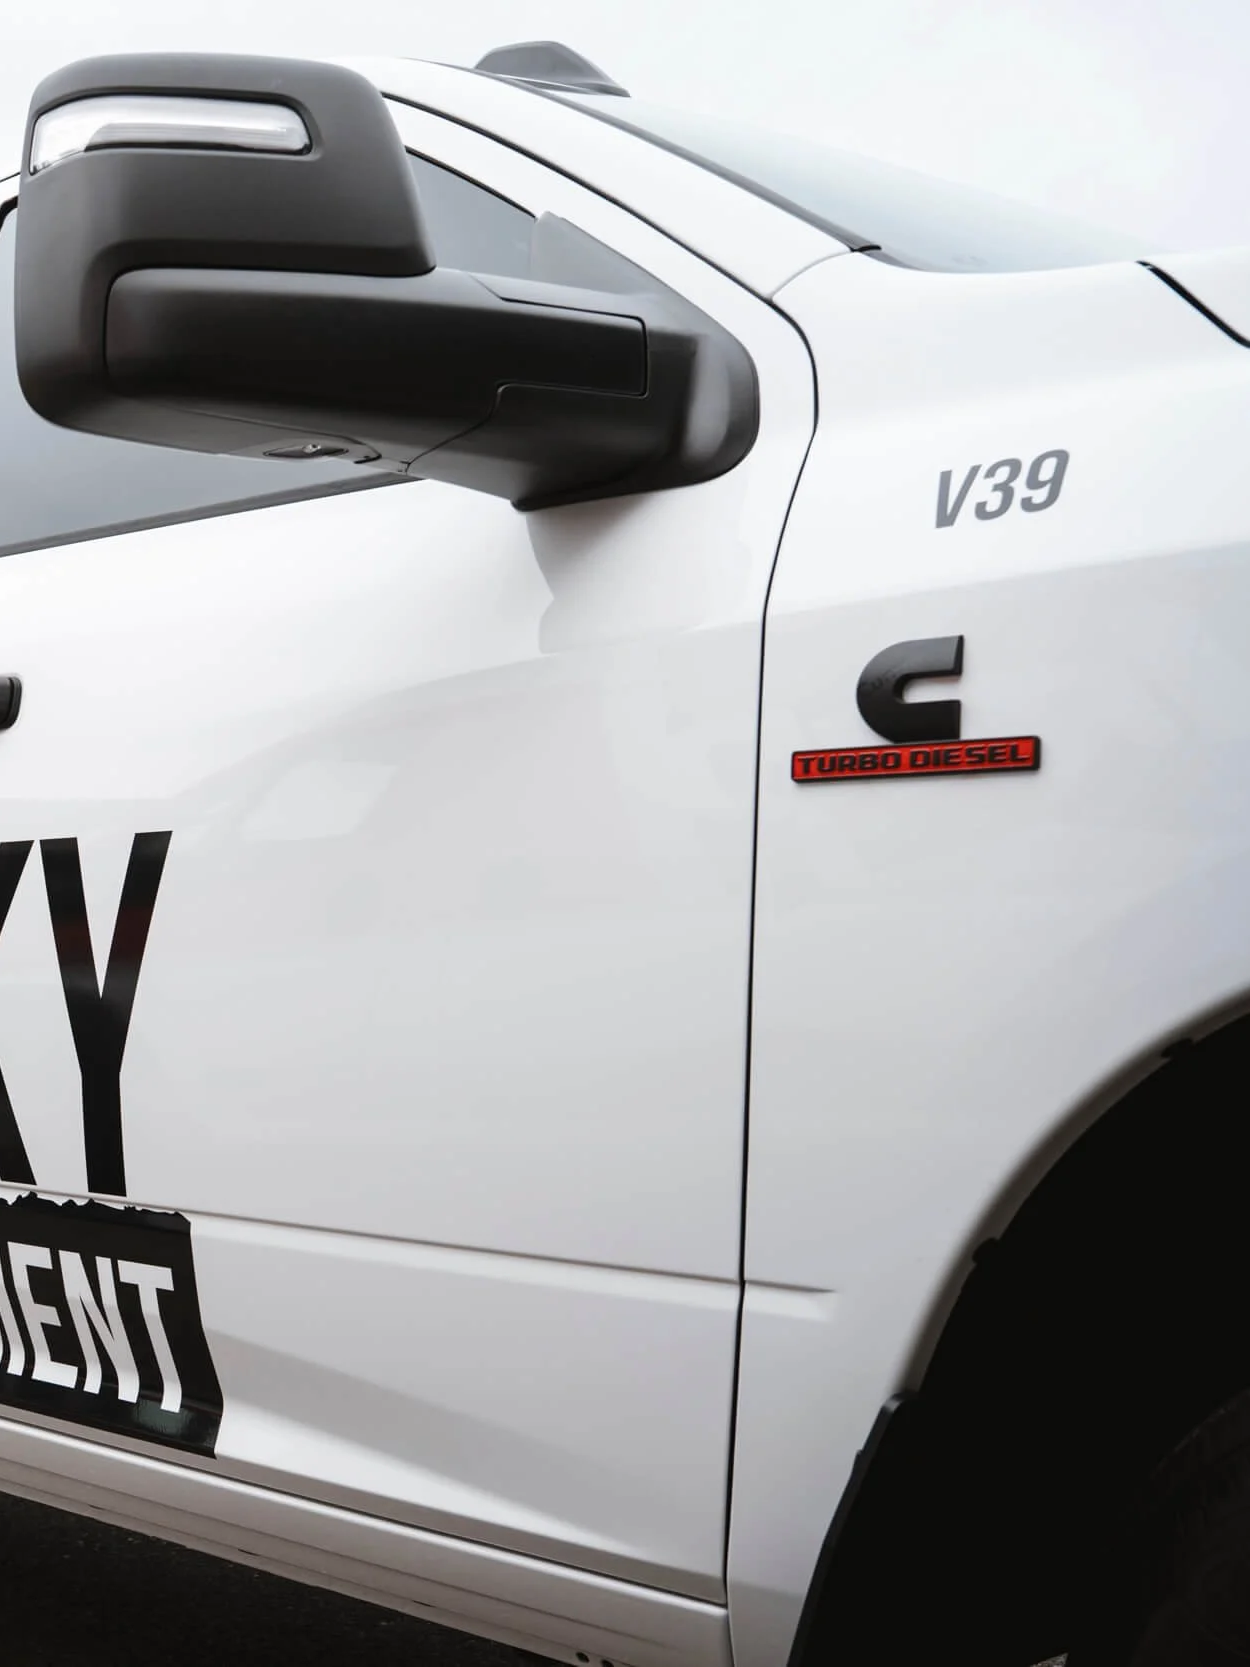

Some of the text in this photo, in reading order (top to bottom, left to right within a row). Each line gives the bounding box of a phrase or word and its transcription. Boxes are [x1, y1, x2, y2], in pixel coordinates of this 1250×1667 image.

[935, 449, 1070, 528] V39
[798, 743, 1031, 775] TURBO DIESEL
